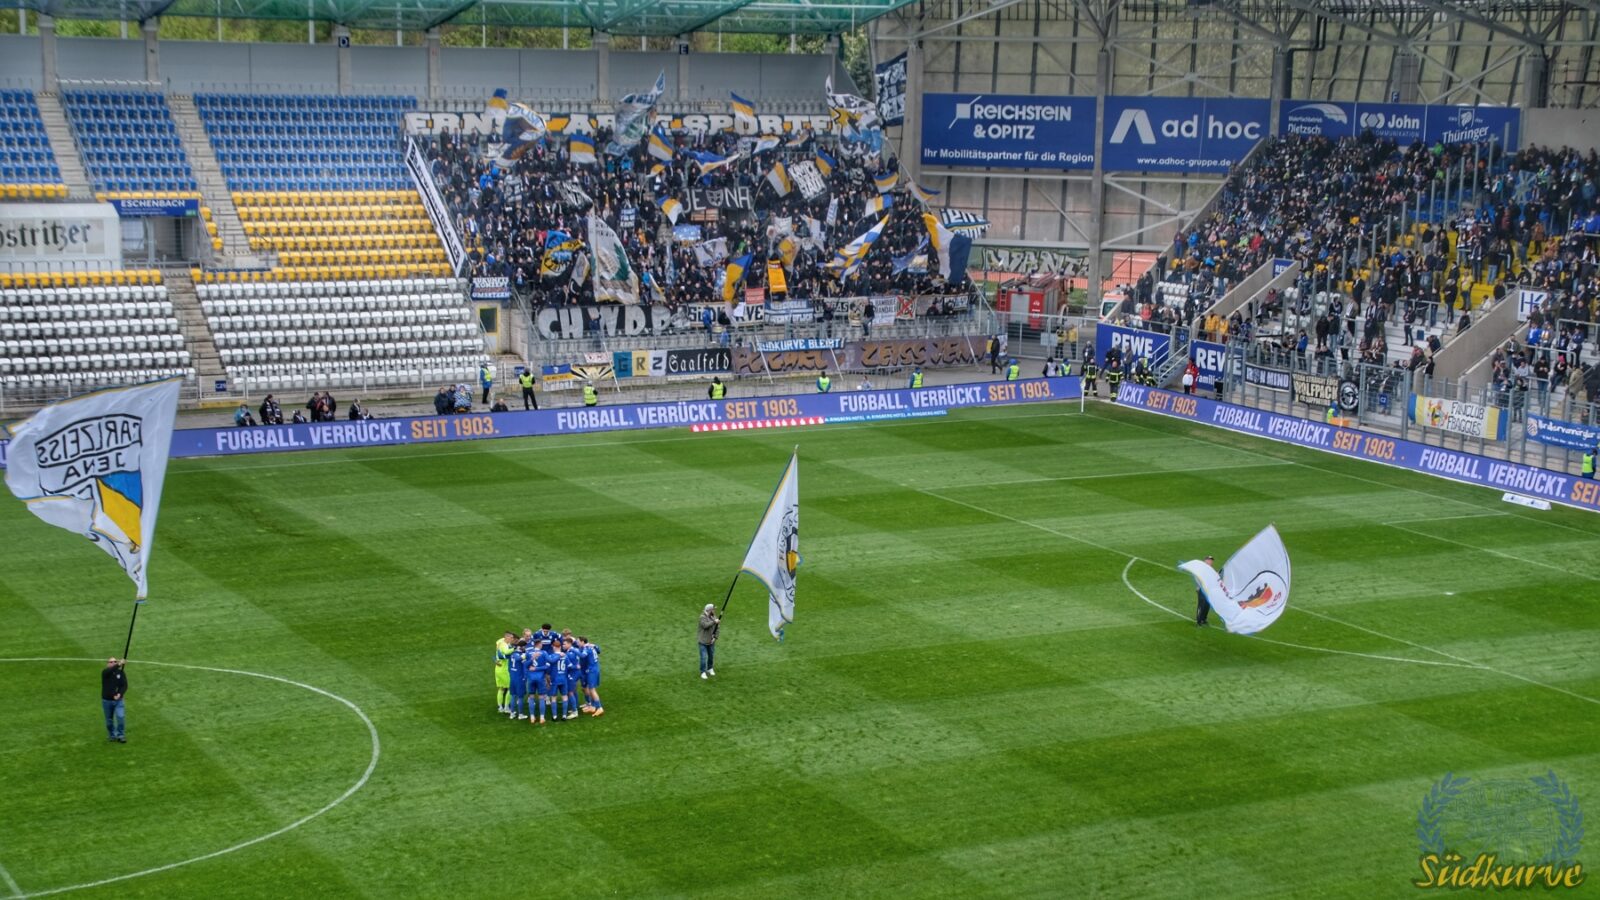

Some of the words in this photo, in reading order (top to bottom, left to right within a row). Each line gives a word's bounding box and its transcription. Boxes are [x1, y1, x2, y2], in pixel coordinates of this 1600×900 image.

[1161, 115, 1199, 139] ad
[1209, 115, 1261, 140] hoc
[1288, 123, 1321, 134] Dietzsch
[1387, 113, 1420, 129] John
[1442, 126, 1489, 144] Thüringer
[924, 148, 938, 158] Ihr
[940, 148, 1023, 162] Mobilitätspartner
[1025, 151, 1039, 162] für
[1041, 152, 1056, 162] die
[1059, 152, 1094, 165] Region
[1137, 156, 1231, 168] www.adhoc-gruppe.de
[120, 199, 186, 208] ESCHENBACH
[1111, 331, 1154, 359] REWE
[668, 353, 730, 373] Saalfeld
[1195, 347, 1242, 377] REWE
[911, 386, 986, 408] VERRÜCKT.
[989, 384, 1016, 399] SEIT
[1020, 381, 1054, 398] 1903.
[1294, 380, 1338, 400] WOLFPACK
[637, 403, 722, 424] VERRÜCKT.
[725, 400, 758, 420] SEIT
[762, 398, 802, 417] 1903.
[1147, 391, 1169, 411] SEIT
[1171, 395, 1198, 417] 1903.
[1451, 401, 1485, 420] FANCLUB
[309, 421, 407, 445] VERRÜCKT.
[411, 419, 448, 439] SEIT
[454, 415, 500, 436] 1903.
[1267, 416, 1329, 446] VERRÜCKT.
[1333, 431, 1363, 452] SEIT
[1364, 437, 1396, 460] 1903.
[1487, 463, 1567, 498] VERRÜCKT.
[557, 660, 566, 671] 16
